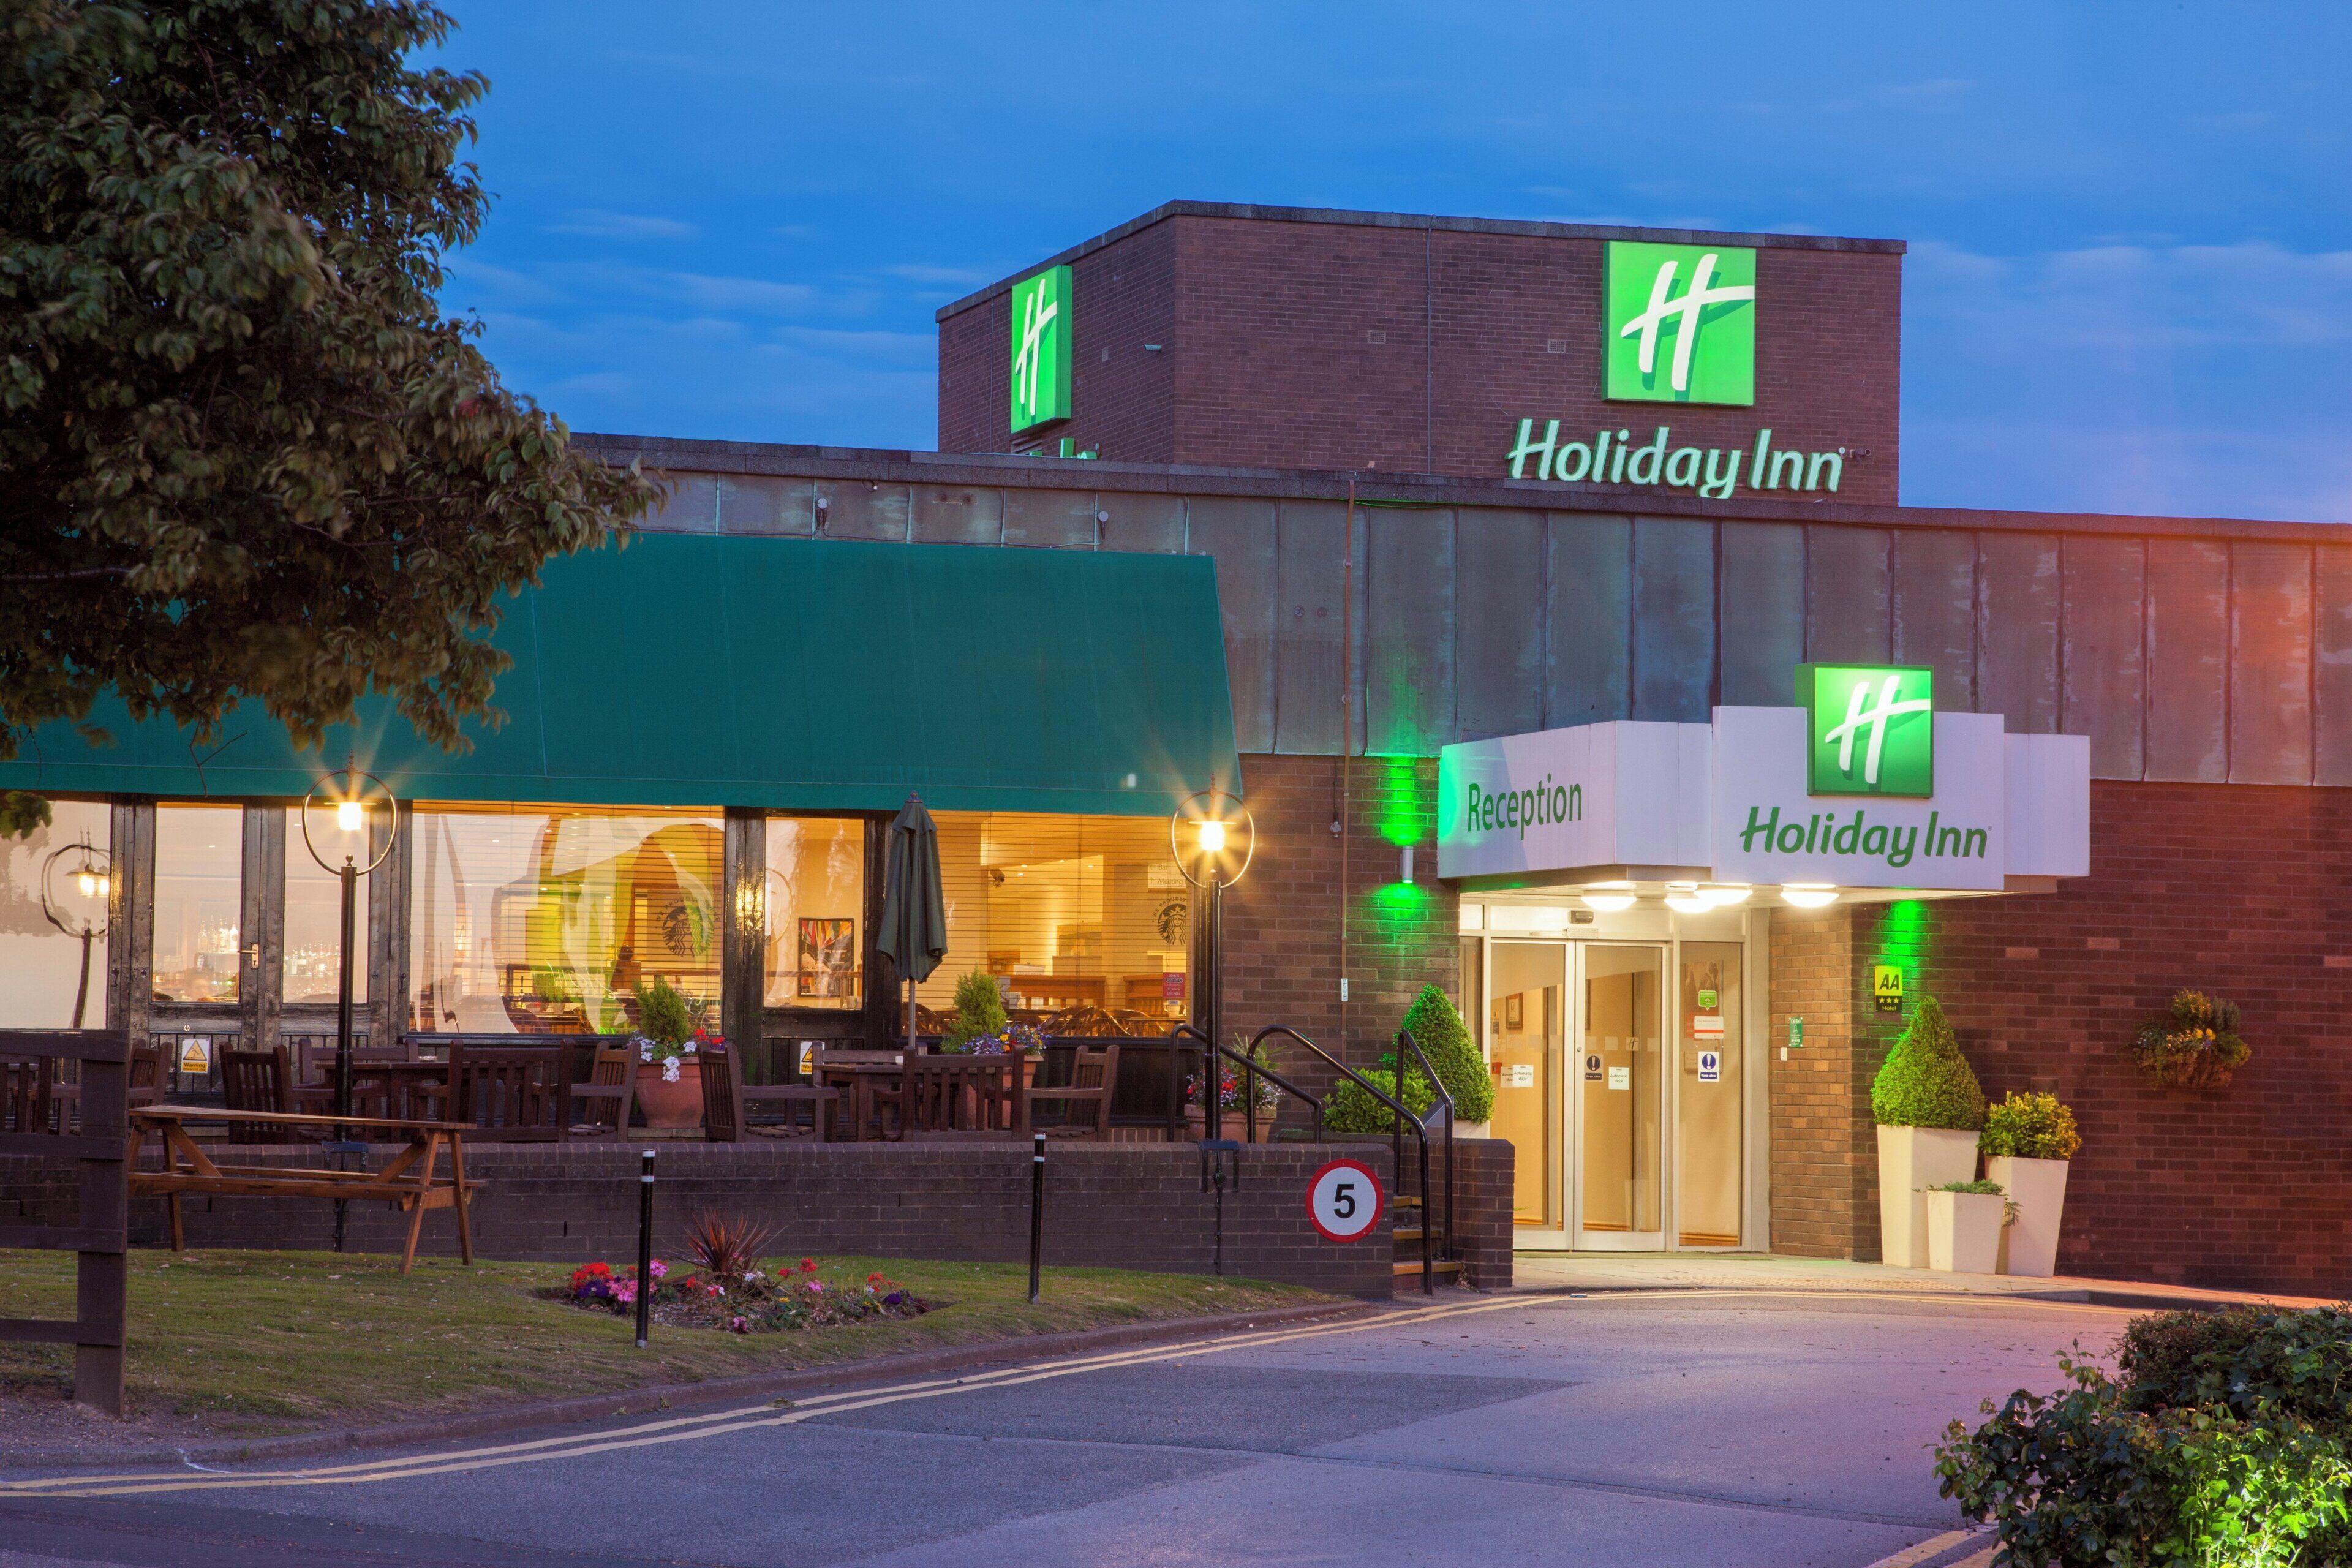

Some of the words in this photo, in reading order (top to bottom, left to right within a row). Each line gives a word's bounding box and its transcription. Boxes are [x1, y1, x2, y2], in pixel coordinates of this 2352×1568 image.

[1505, 418, 1742, 499] Holiday
[1747, 429, 1844, 492] Inn
[1468, 773, 1583, 840] Reception
[1740, 806, 1918, 868] Holiday
[1924, 811, 1988, 859] Inn
[1879, 974, 1899, 990] AA
[1333, 1183, 1356, 1219] 5
